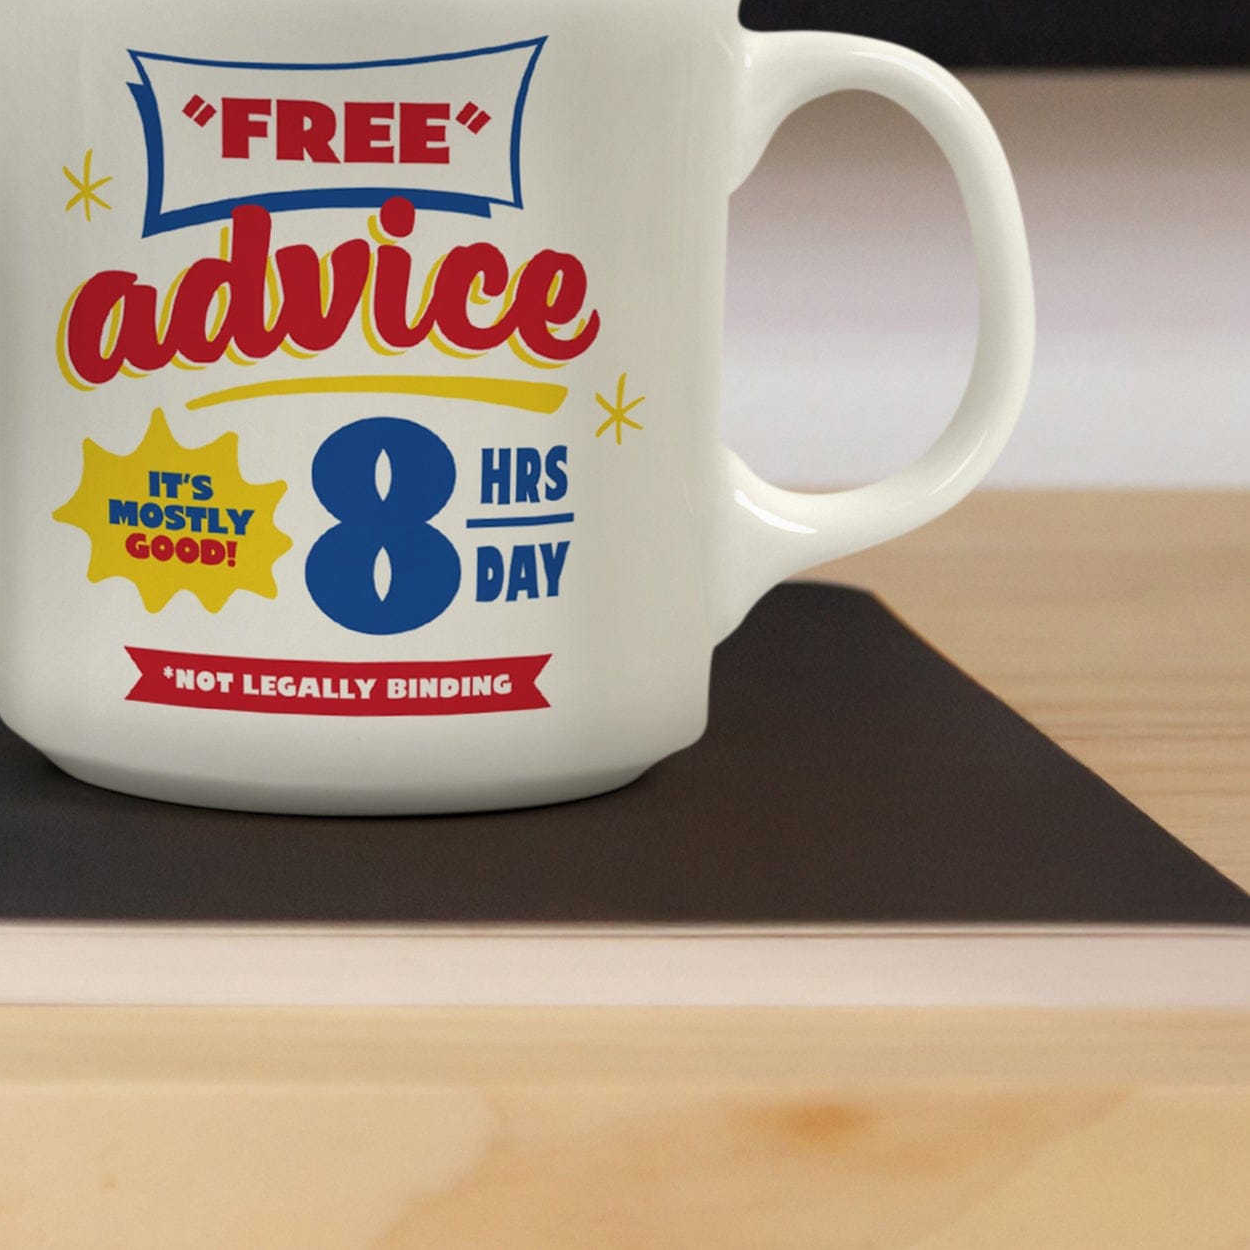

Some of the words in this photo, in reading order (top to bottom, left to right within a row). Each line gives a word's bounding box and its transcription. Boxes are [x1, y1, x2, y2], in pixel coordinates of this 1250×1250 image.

[56, 196, 600, 392] advice
[148, 470, 213, 501] IT'S
[480, 445, 569, 505] HRS
[108, 499, 255, 536] MOSTLY
[305, 416, 461, 636] 8
[125, 532, 238, 568] GOOD!
[475, 540, 571, 603] DAY
[243, 674, 377, 700] LEGALLY
[386, 673, 512, 699] BINDING
